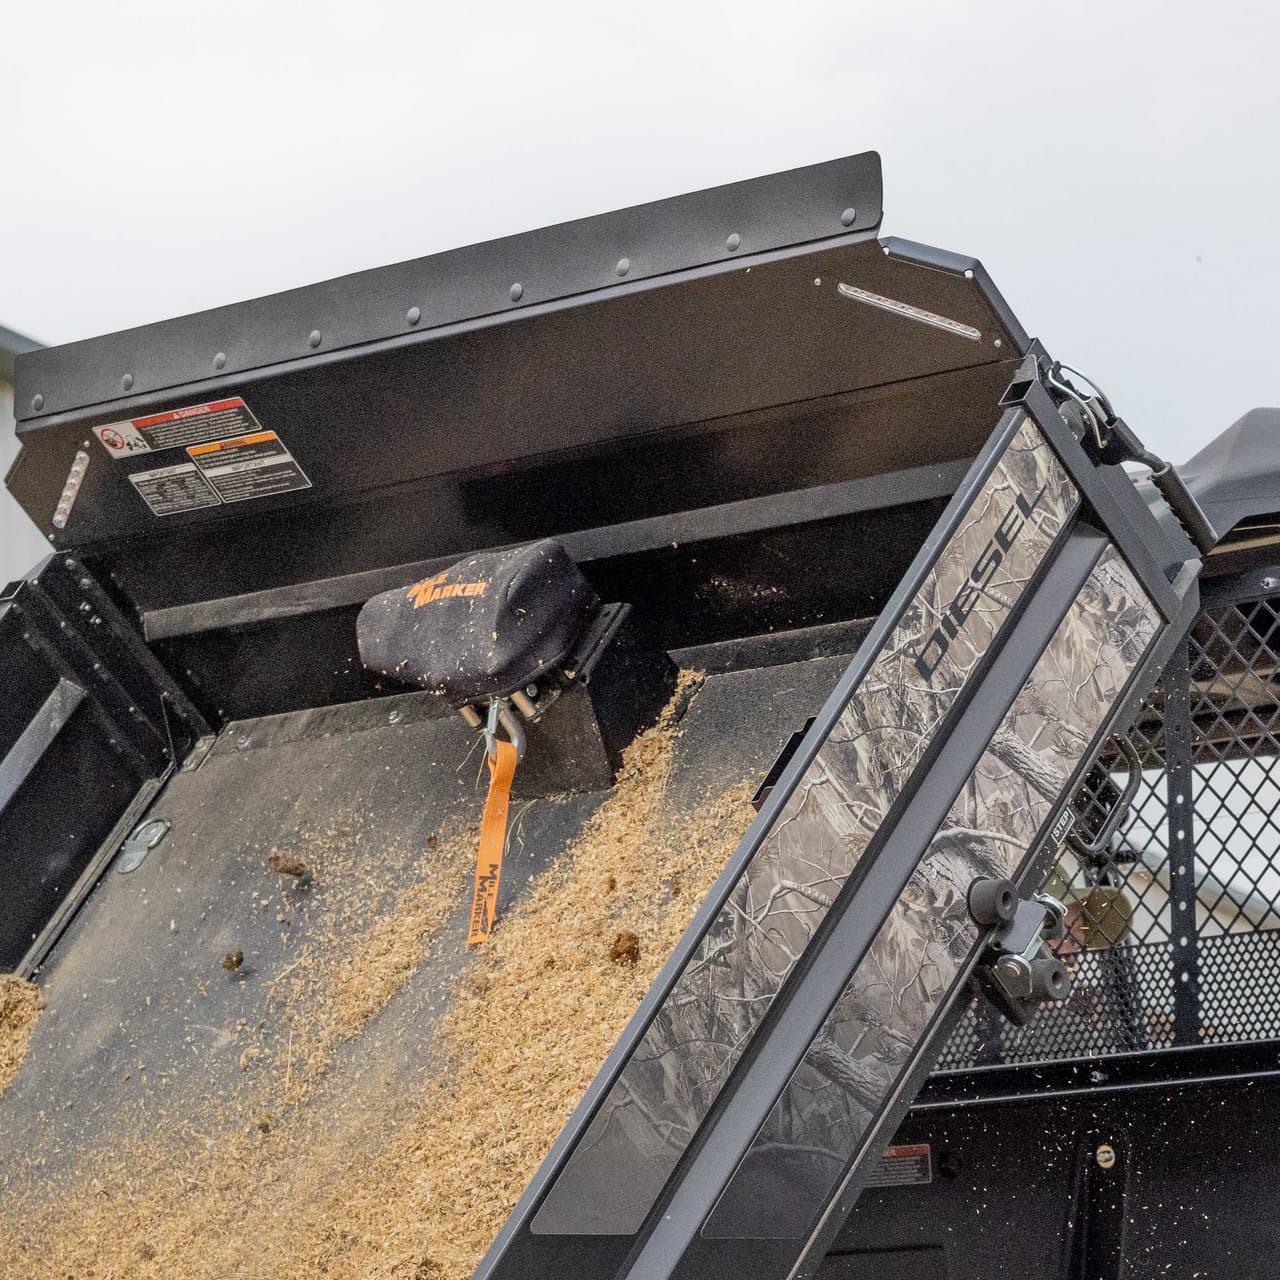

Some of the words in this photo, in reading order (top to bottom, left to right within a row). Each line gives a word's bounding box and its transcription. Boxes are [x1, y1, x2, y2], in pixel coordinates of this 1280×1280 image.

[413, 581, 488, 609] MARKER
[915, 484, 1047, 683] DIESEL
[1052, 810, 1070, 838] STEP
